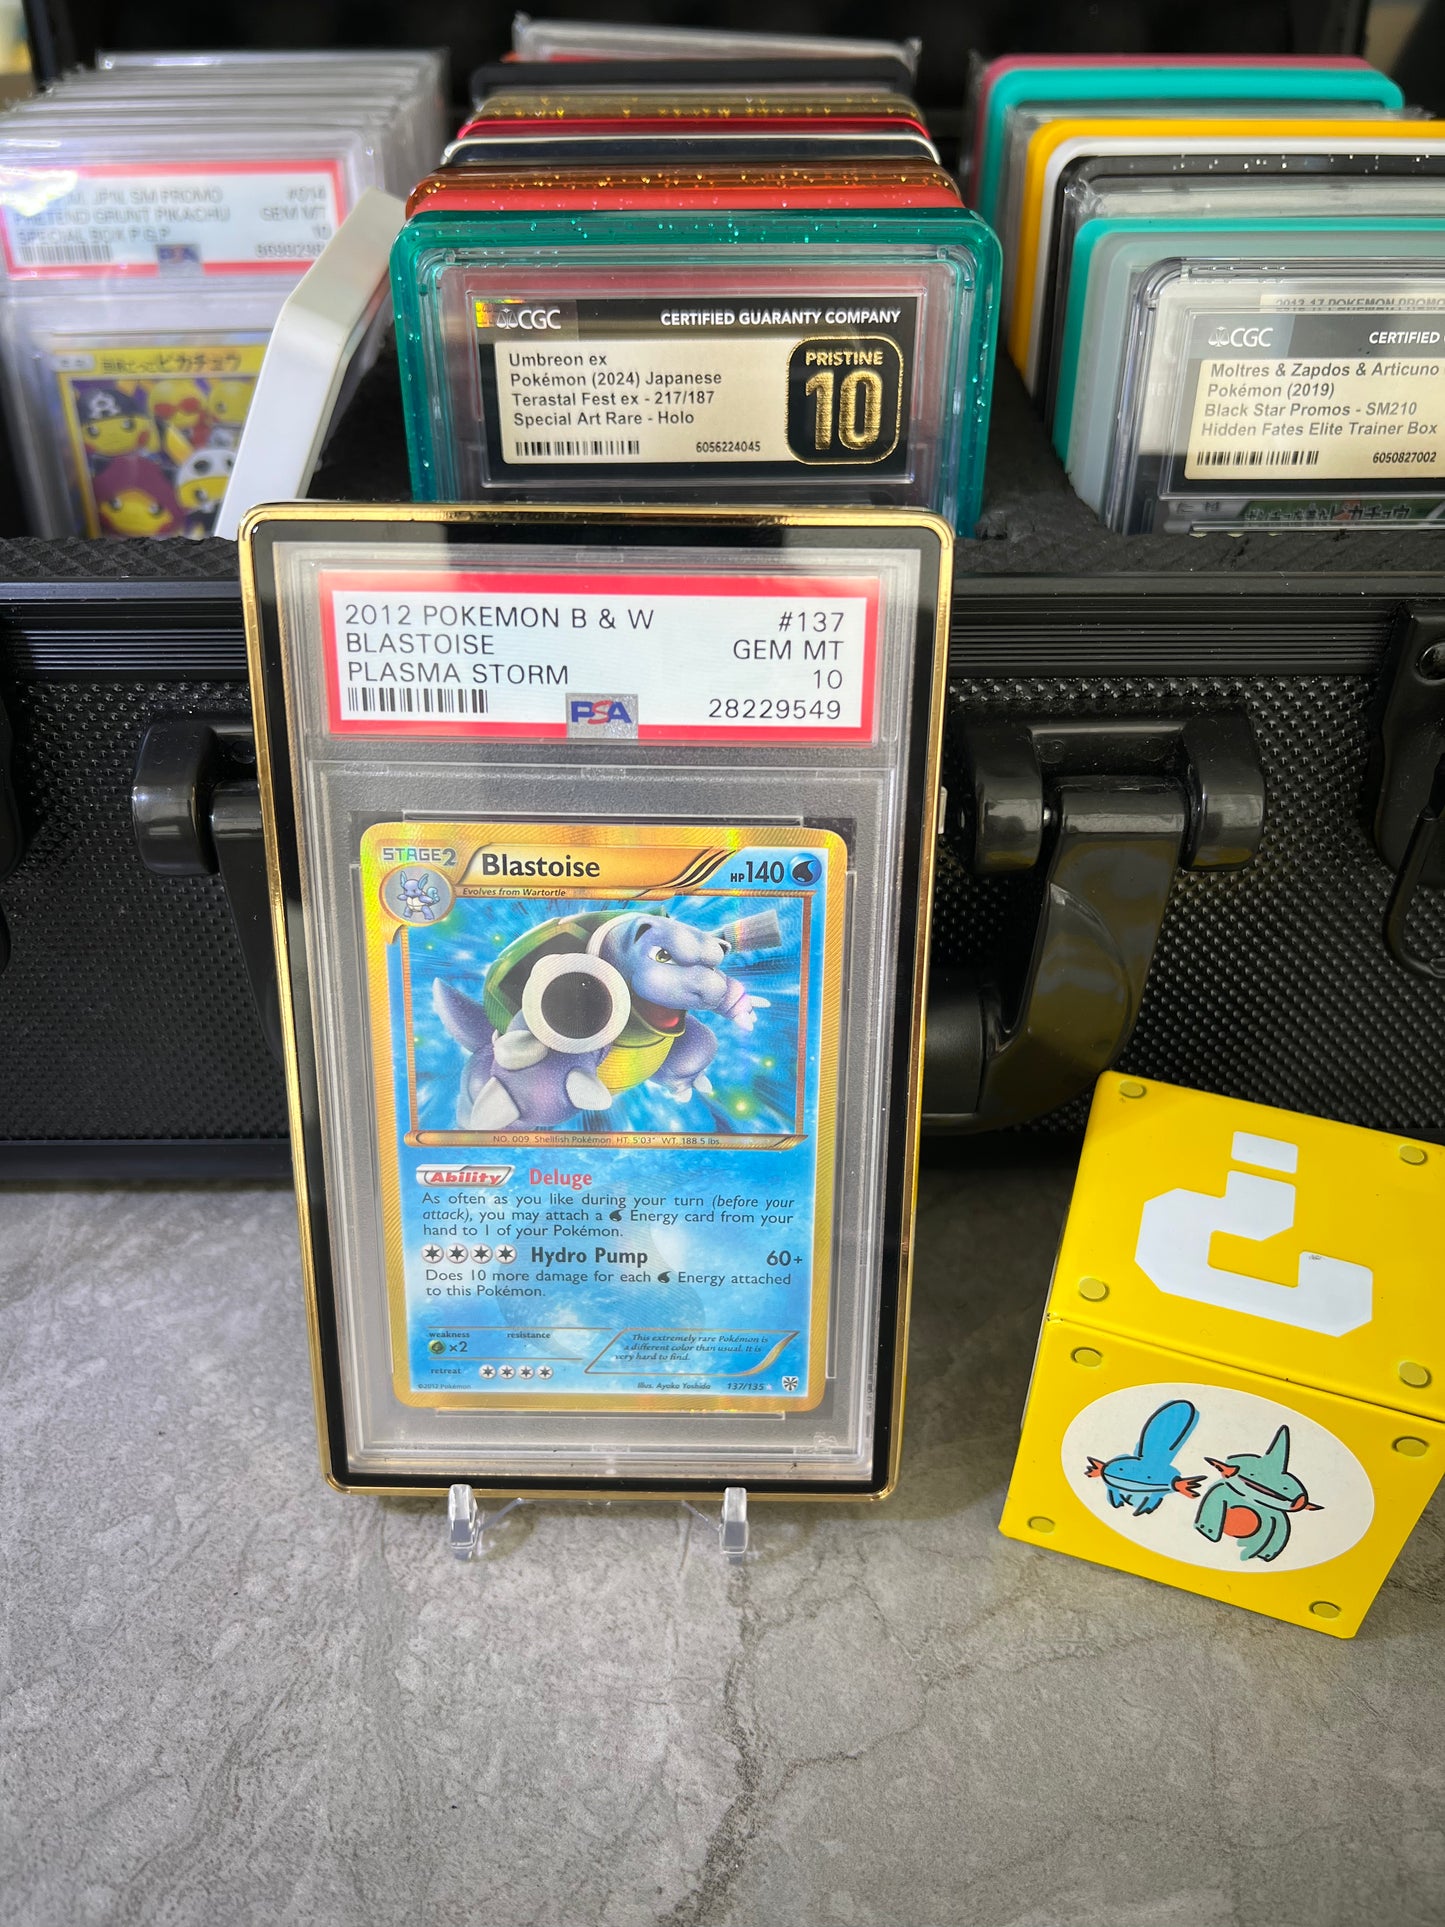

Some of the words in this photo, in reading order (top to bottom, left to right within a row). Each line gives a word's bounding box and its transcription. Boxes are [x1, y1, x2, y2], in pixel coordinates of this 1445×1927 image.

[161, 187, 224, 201] PROMO
[154, 206, 230, 222] PIKACHU
[518, 309, 561, 329] CGC
[661, 311, 734, 325] CERTIFIED
[739, 311, 821, 325] GUARANTY
[825, 310, 900, 324] COMPANY
[1231, 328, 1273, 347] CGC
[1369, 332, 1440, 343] CERTIFIED
[509, 353, 583, 366] Umbreon
[590, 355, 607, 365] ex
[806, 351, 883, 366] PRISTINE
[1211, 364, 1269, 376] Moltres
[1275, 364, 1286, 376] &
[1291, 363, 1350, 379] Zapdos
[1356, 363, 1366, 376] &
[1371, 362, 1439, 376] Articuno
[511, 373, 585, 386] Pokémon
[592, 372, 639, 388] (2024)
[645, 371, 722, 387] Japanese
[512, 393, 576, 406] Terastal
[583, 393, 616, 405] Fest
[621, 395, 638, 405] ex
[655, 391, 714, 405] 217/187
[1208, 384, 1281, 397] Pokémon
[1287, 383, 1334, 399] (2019)
[806, 370, 882, 450] 10
[1205, 404, 1247, 417] Black
[1253, 403, 1286, 417] Star
[1290, 403, 1350, 416] Promos
[1366, 402, 1417, 415] SM210
[514, 413, 571, 428] Special
[578, 413, 600, 425] Art
[607, 412, 642, 424] Rare
[658, 411, 694, 424] Holo
[1201, 423, 1256, 436] Hidden
[1262, 423, 1303, 436] Fates
[1309, 423, 1342, 435] Elite
[1349, 422, 1406, 435] Trainer
[1408, 422, 1437, 434] Box
[696, 441, 760, 452] 6056224045
[1372, 452, 1436, 464] 6050827002
[346, 604, 411, 625] 2012
[424, 606, 559, 628] POKEMON
[572, 608, 586, 628] B
[600, 609, 616, 629] &
[628, 609, 654, 629] W
[779, 612, 844, 632] #137
[347, 633, 494, 654] BLASTOISE
[734, 640, 791, 660] GEM
[804, 640, 844, 660] MT
[349, 662, 461, 682] PLASMA
[473, 664, 568, 684] STORM
[813, 670, 842, 689] 10
[571, 700, 632, 724] PSA
[709, 699, 840, 719] 28229549
[482, 854, 600, 877] Blastoise
[572, 1136, 611, 1144] Pokémon
[431, 1172, 502, 1185] Ability
[530, 1169, 592, 1190] Deluge
[422, 1193, 440, 1204] As
[449, 1193, 485, 1204] often
[494, 1196, 508, 1204] as
[516, 1196, 541, 1208] you
[550, 1193, 573, 1205] like
[582, 1194, 626, 1209] during
[634, 1197, 666, 1208] your
[674, 1196, 703, 1206] turn
[712, 1195, 758, 1208] (before
[766, 1200, 794, 1210] your
[423, 1209, 473, 1223] attack),
[479, 1212, 505, 1224] you
[512, 1212, 539, 1225] may
[546, 1210, 589, 1221] attach
[596, 1213, 602, 1221] a
[631, 1211, 678, 1225] Energy
[685, 1211, 714, 1222] card
[721, 1211, 754, 1223] from
[761, 1215, 793, 1227] your
[424, 1225, 456, 1235] hand
[463, 1226, 477, 1236] to
[497, 1225, 510, 1236] of
[516, 1228, 548, 1239] your
[553, 1225, 623, 1237] Pokémon.
[532, 1247, 586, 1267] Hydro
[595, 1248, 648, 1267] Pump
[767, 1251, 802, 1266] 60+
[426, 1270, 462, 1281] Does
[471, 1270, 486, 1281] 10
[493, 1273, 529, 1281] more
[536, 1270, 588, 1284] damage
[594, 1271, 614, 1282] for
[620, 1272, 651, 1282] each
[678, 1272, 725, 1287] Energy
[731, 1274, 791, 1285] attached
[427, 1287, 441, 1296] to
[447, 1285, 471, 1296] this
[477, 1285, 546, 1297] Pokémon.
